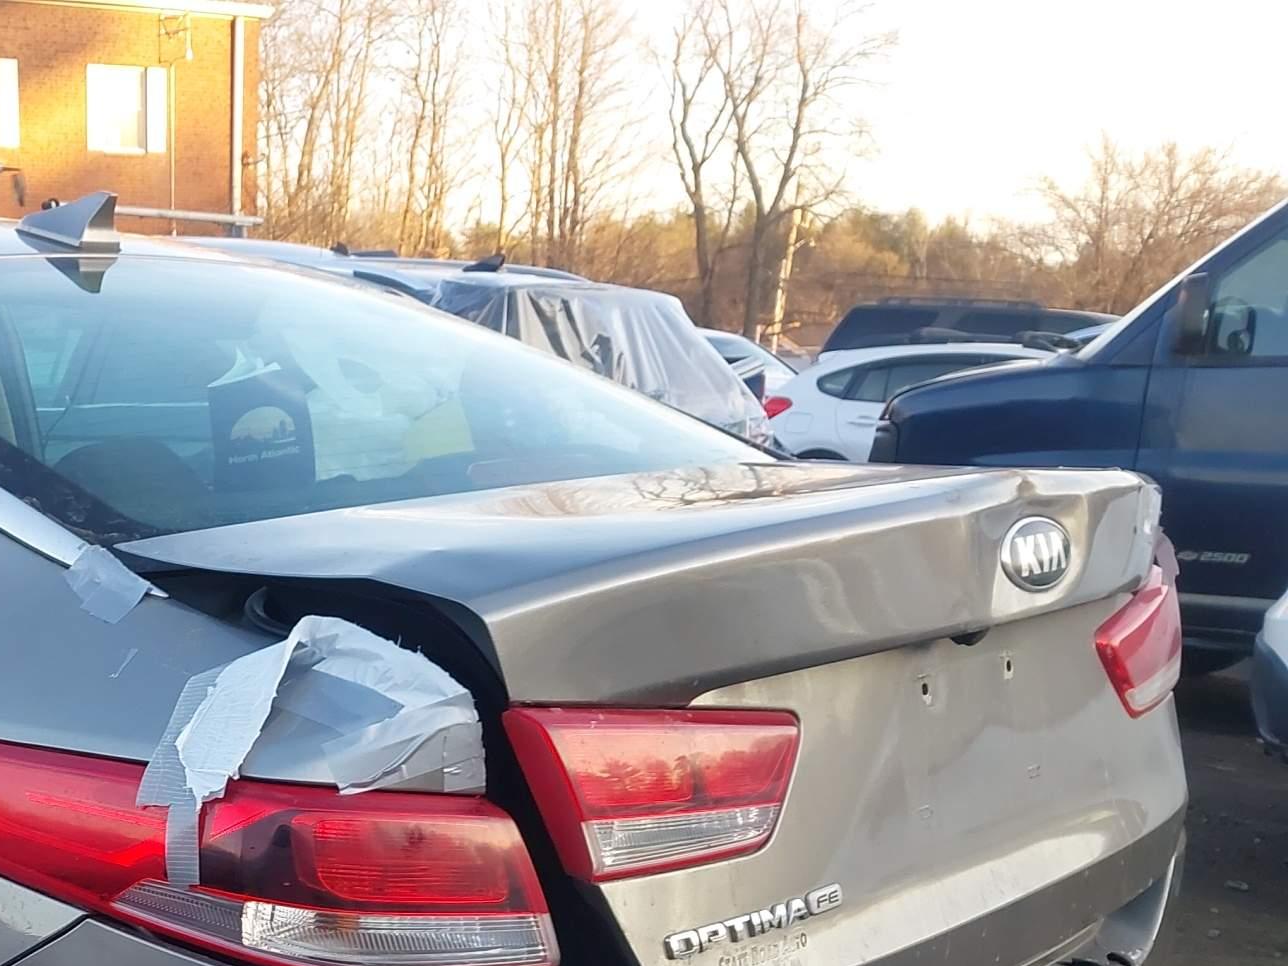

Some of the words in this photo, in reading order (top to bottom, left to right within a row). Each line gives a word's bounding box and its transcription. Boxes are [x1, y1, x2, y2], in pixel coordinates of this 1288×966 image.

[1014, 531, 1066, 577] KIA
[1200, 551, 1251, 563] 2500
[663, 898, 811, 960] OPTIMA
